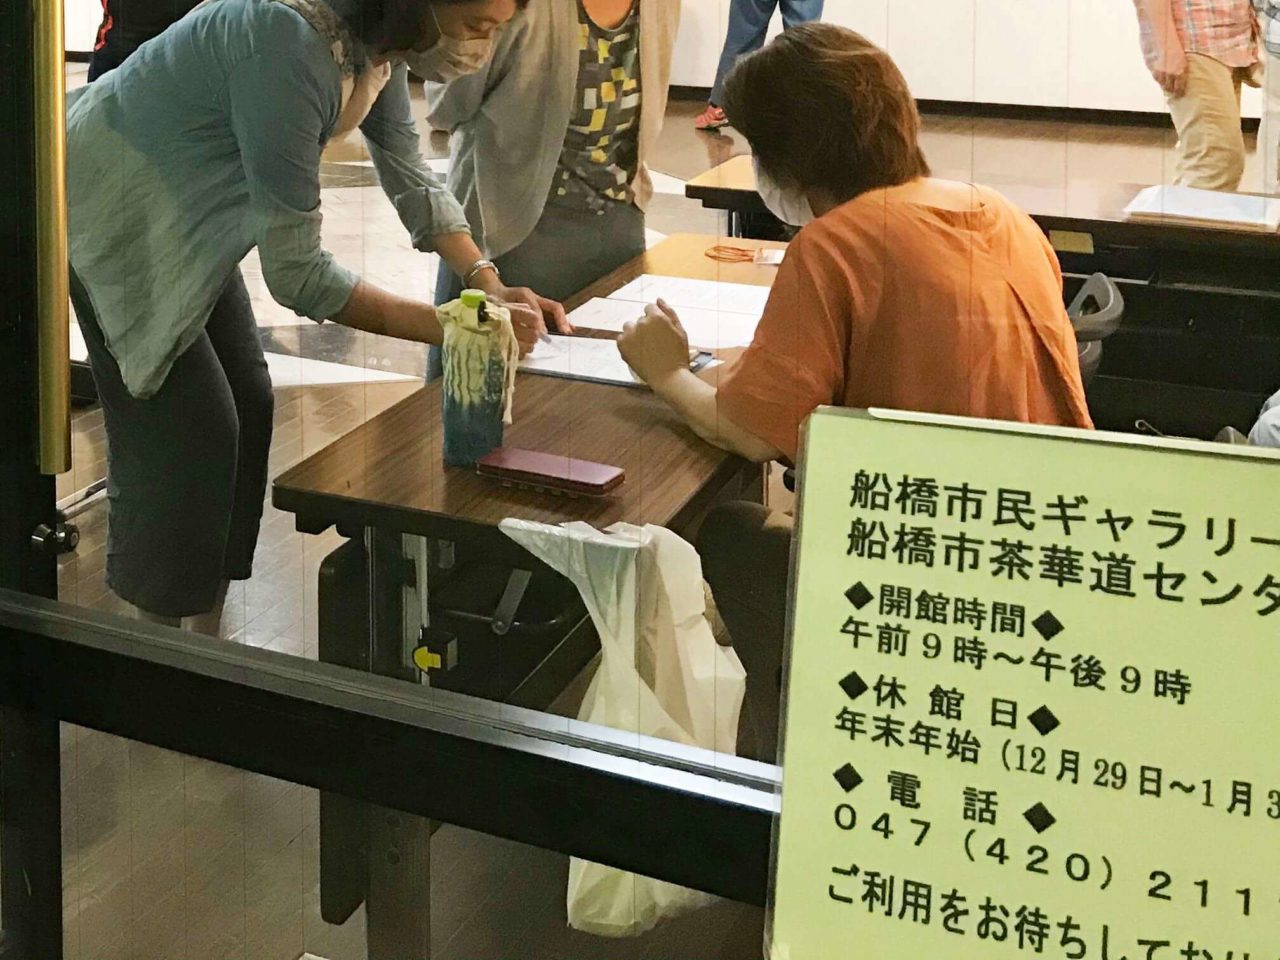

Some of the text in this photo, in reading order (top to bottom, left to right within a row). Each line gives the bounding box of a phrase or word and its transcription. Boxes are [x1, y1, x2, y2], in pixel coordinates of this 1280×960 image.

[850, 467, 1280, 556] 船橋市民ギャラリー
[846, 515, 1280, 618] 船橋市茶華道センタ
[878, 583, 1027, 638] 開館時間
